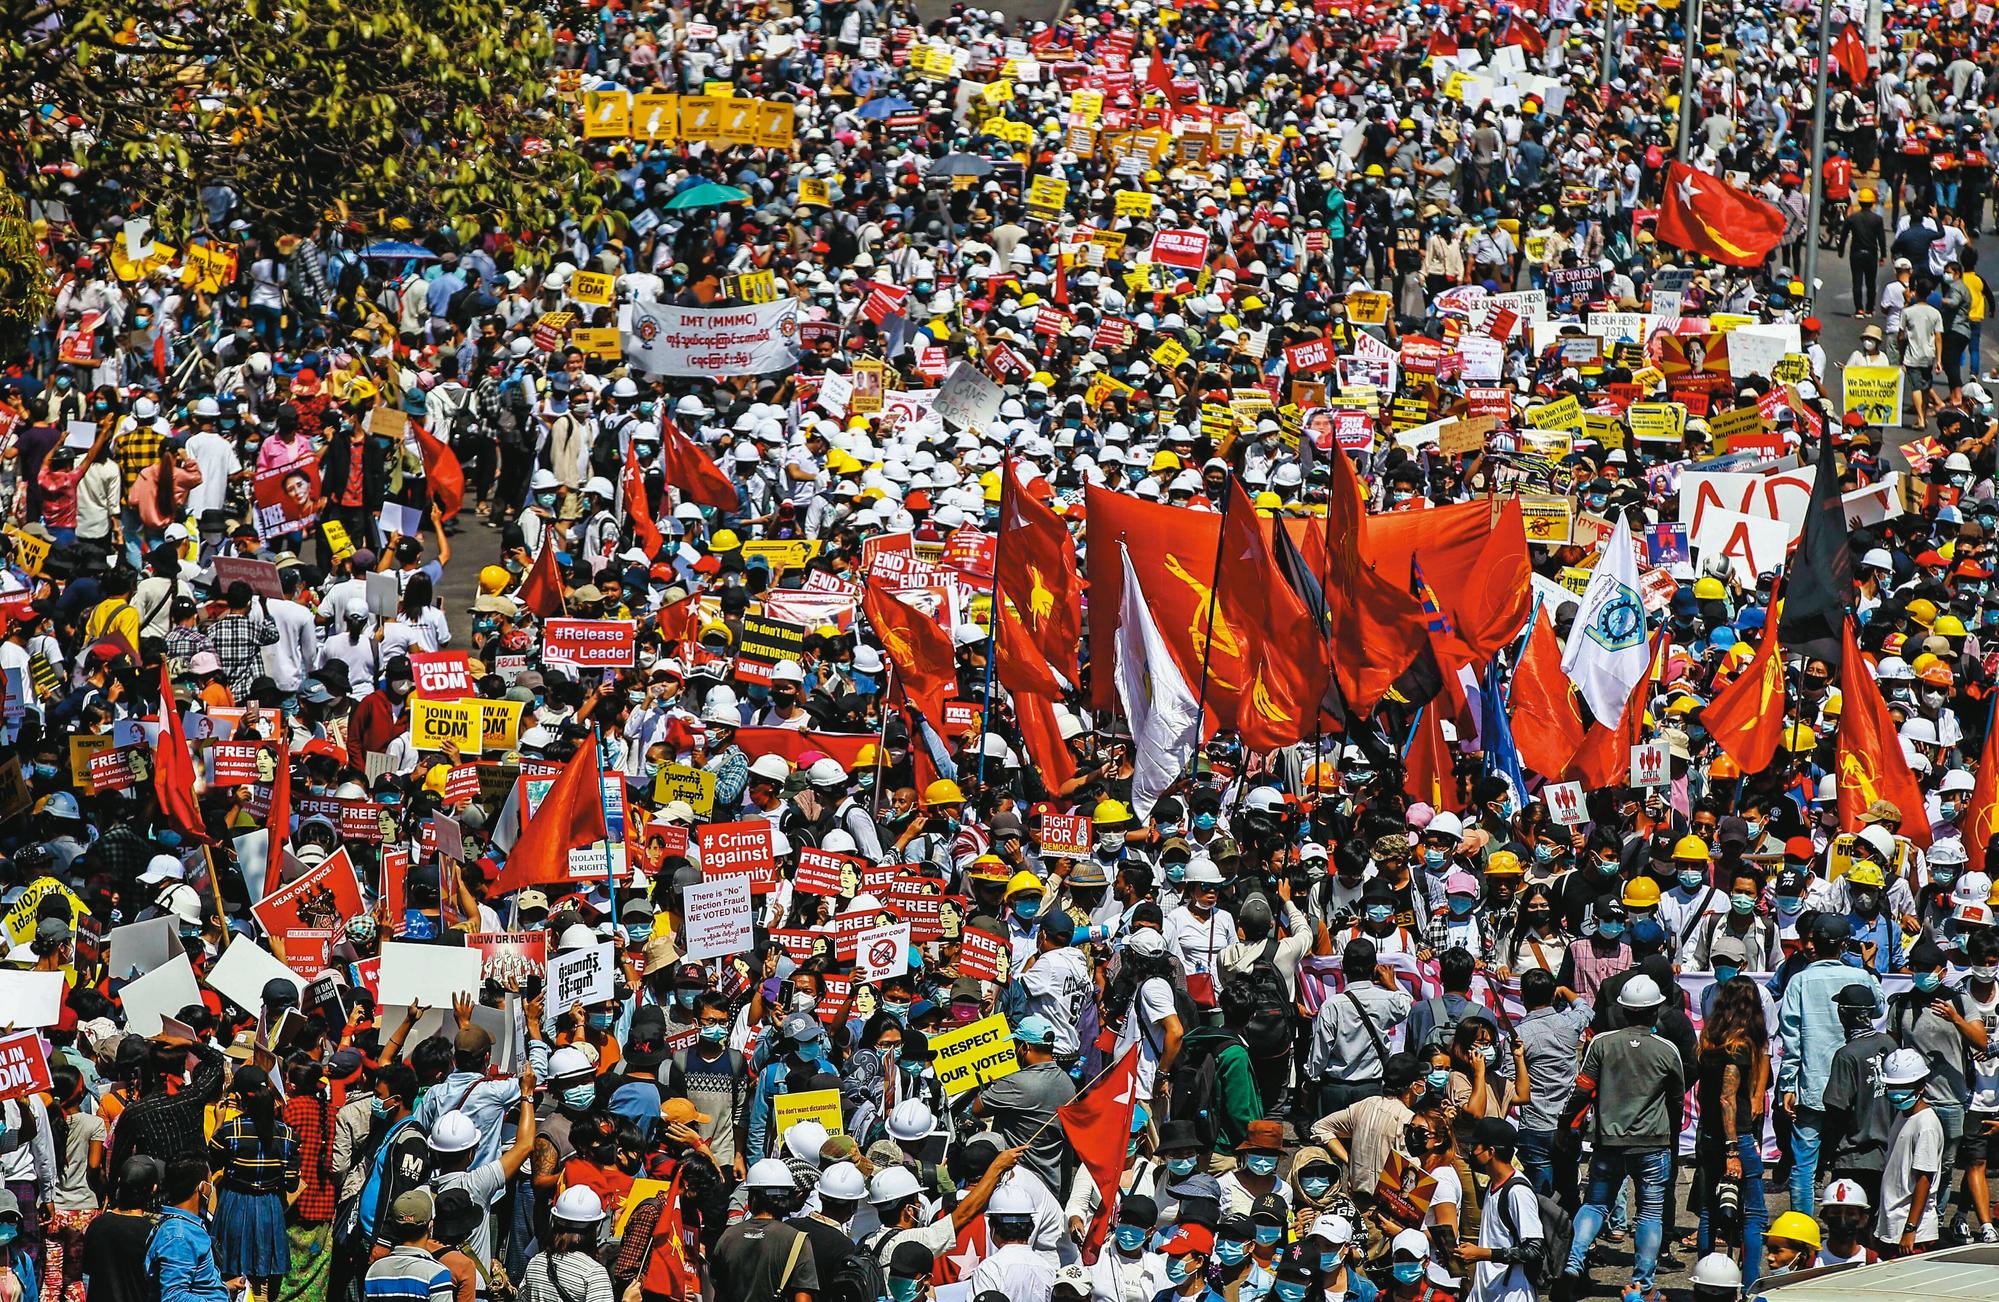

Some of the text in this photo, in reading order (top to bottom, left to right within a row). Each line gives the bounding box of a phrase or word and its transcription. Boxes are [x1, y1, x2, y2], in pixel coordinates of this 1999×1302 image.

[1158, 234, 1205, 248] END THE
[1570, 280, 1592, 292] JOIN
[680, 312, 758, 329] IMT (MMMC)
[1039, 309, 1062, 321] FREE
[1600, 316, 1616, 325] OUR
[1101, 319, 1124, 329] FREE
[576, 332, 590, 340] FREE
[822, 328, 839, 336] THE
[1604, 327, 1628, 337] JOIN
[1722, 522, 1759, 579] A
[874, 552, 904, 572] END
[908, 560, 936, 574] THE
[810, 572, 840, 593] END
[900, 572, 958, 588] END THE
[554, 627, 624, 641] #Release
[744, 620, 804, 642] We don't Want
[546, 645, 630, 659] Our Leader
[740, 640, 801, 662] DICTATORSHIP
[450, 661, 464, 672] IN
[738, 662, 758, 675] SAVE
[456, 708, 468, 721] IN
[496, 707, 509, 718] IN
[482, 716, 512, 734] DM"
[216, 746, 256, 758] FREE
[90, 752, 127, 770] FREE
[104, 766, 130, 777] LEADERS
[446, 766, 477, 782] FREE
[520, 762, 556, 775] FREE
[1642, 770, 1660, 779] CIVIL
[300, 800, 340, 814] FREE
[342, 808, 377, 820] FREE
[1043, 816, 1075, 828] FIGHT
[704, 832, 766, 848] # Crime
[1043, 828, 1072, 844] FOR
[704, 848, 769, 868] against
[800, 852, 840, 870] FREE
[812, 870, 840, 881] LEADERS
[272, 868, 332, 908] HEAR OUR VOICE
[692, 886, 743, 903] There is "No"
[890, 882, 922, 894] FREE
[690, 896, 746, 912] Election Fraud
[896, 900, 938, 913] FREE
[688, 904, 749, 922] WE VOTED NLD
[836, 915, 874, 932] FREE
[469, 934, 545, 944] NOW OR NEVER
[862, 928, 906, 942] MILITARY COUP
[964, 932, 998, 952] FREE
[974, 952, 996, 964] LEADERS
[872, 968, 890, 978] END
[320, 980, 334, 992] DAY
[320, 990, 336, 1002] NIGHT
[940, 1028, 1000, 1060] RESPECT
[940, 1048, 1016, 1084] OUR VOTES
[402, 1153, 424, 1173] M
